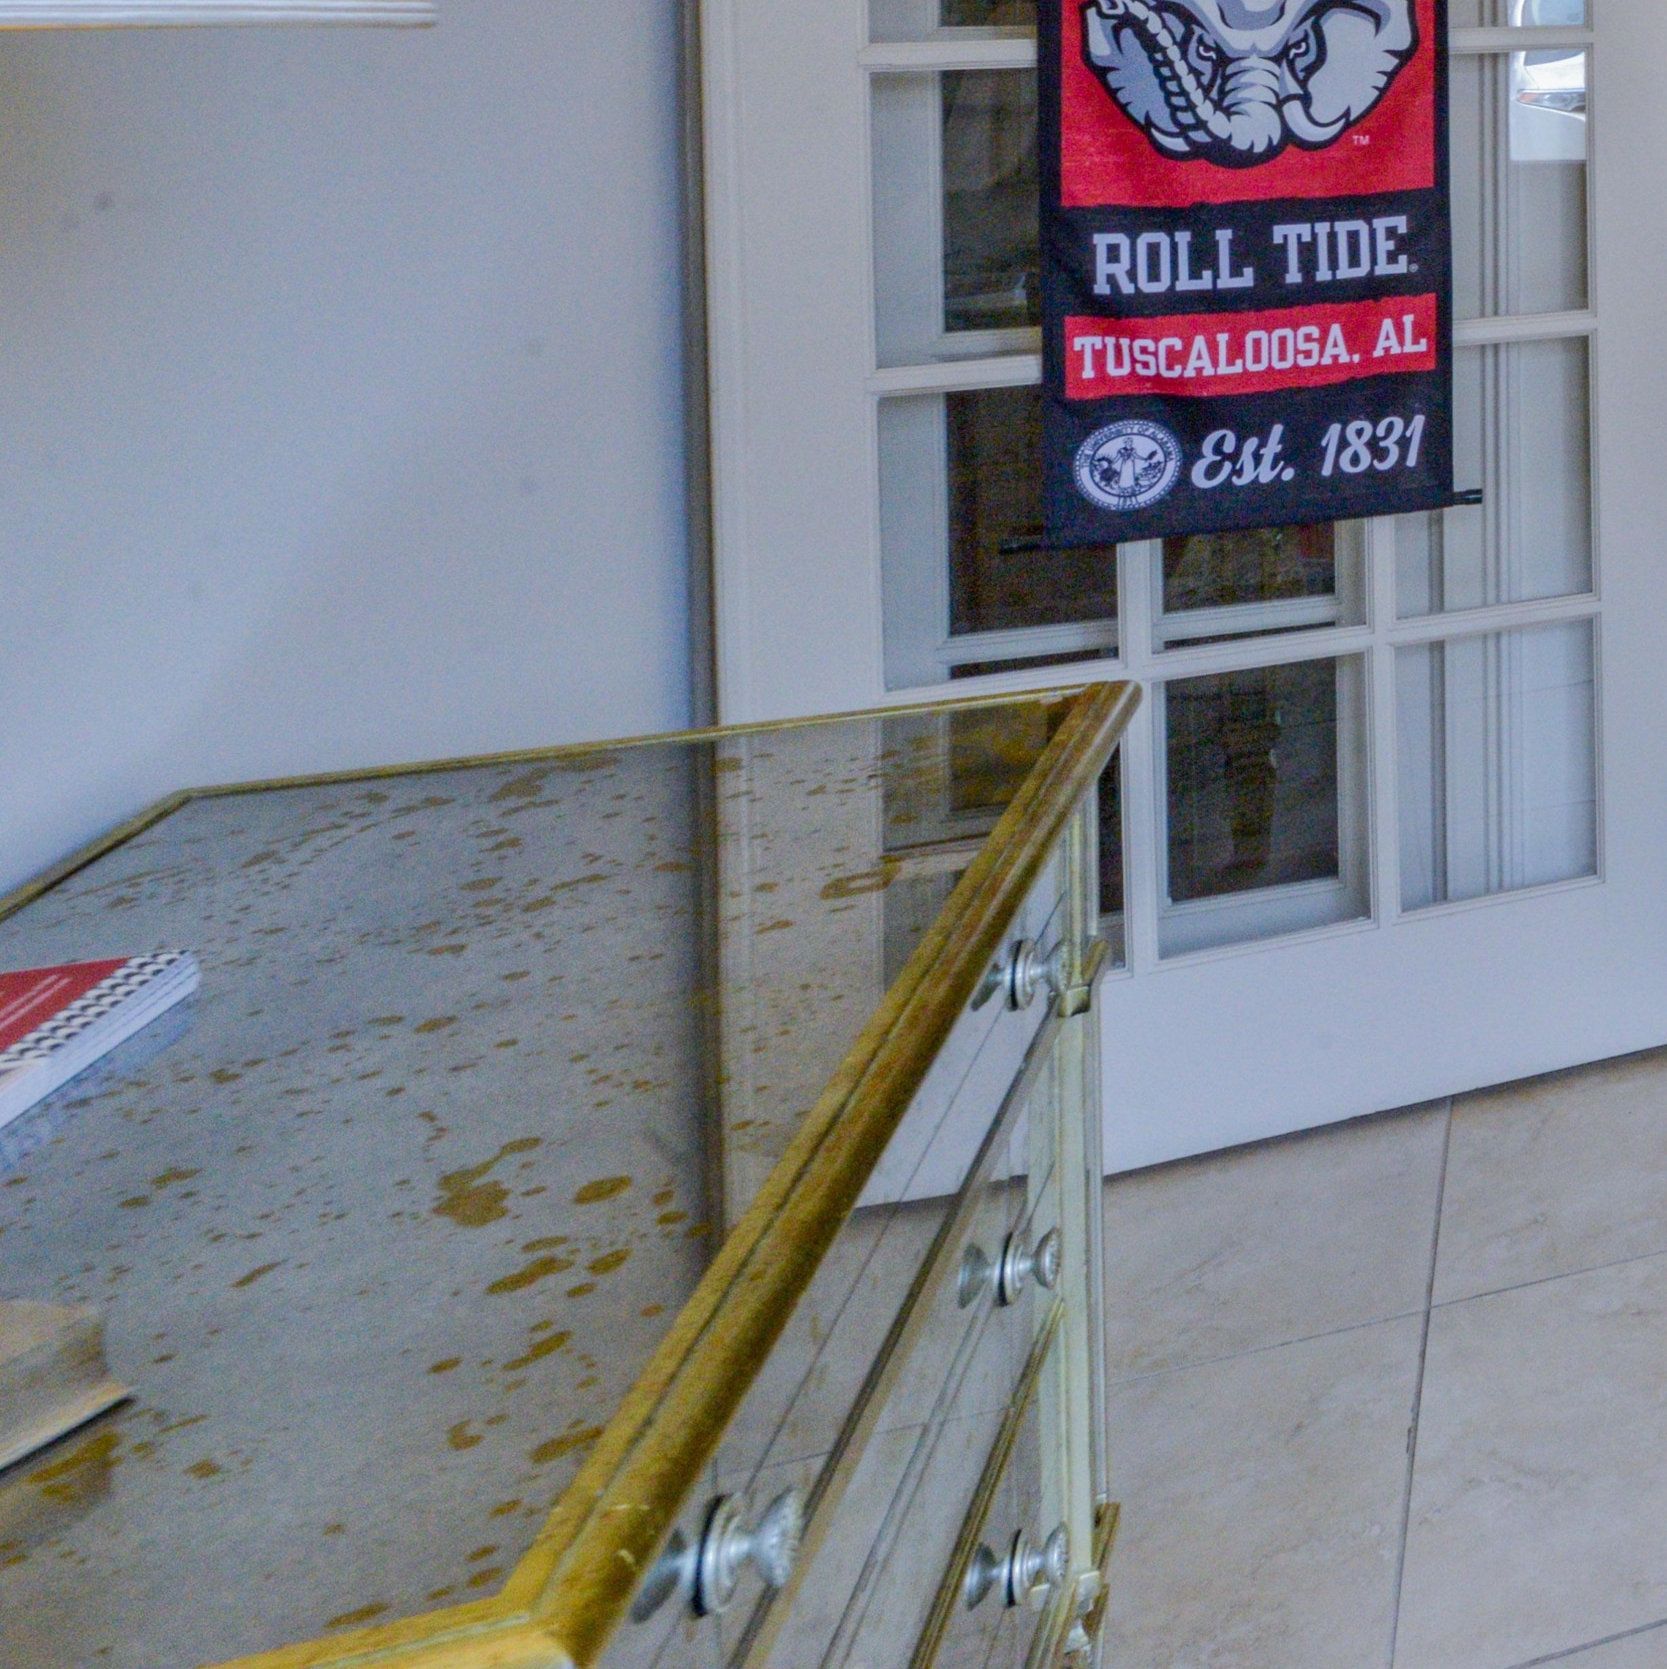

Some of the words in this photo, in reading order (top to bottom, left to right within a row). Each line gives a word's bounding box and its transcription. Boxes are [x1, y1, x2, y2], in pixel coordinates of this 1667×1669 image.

[1093, 229, 1254, 294] ROLL
[1273, 215, 1408, 284] TIDE
[1373, 314, 1427, 358] AL
[1191, 424, 1295, 489] Est.
[1321, 414, 1425, 477] 1831
